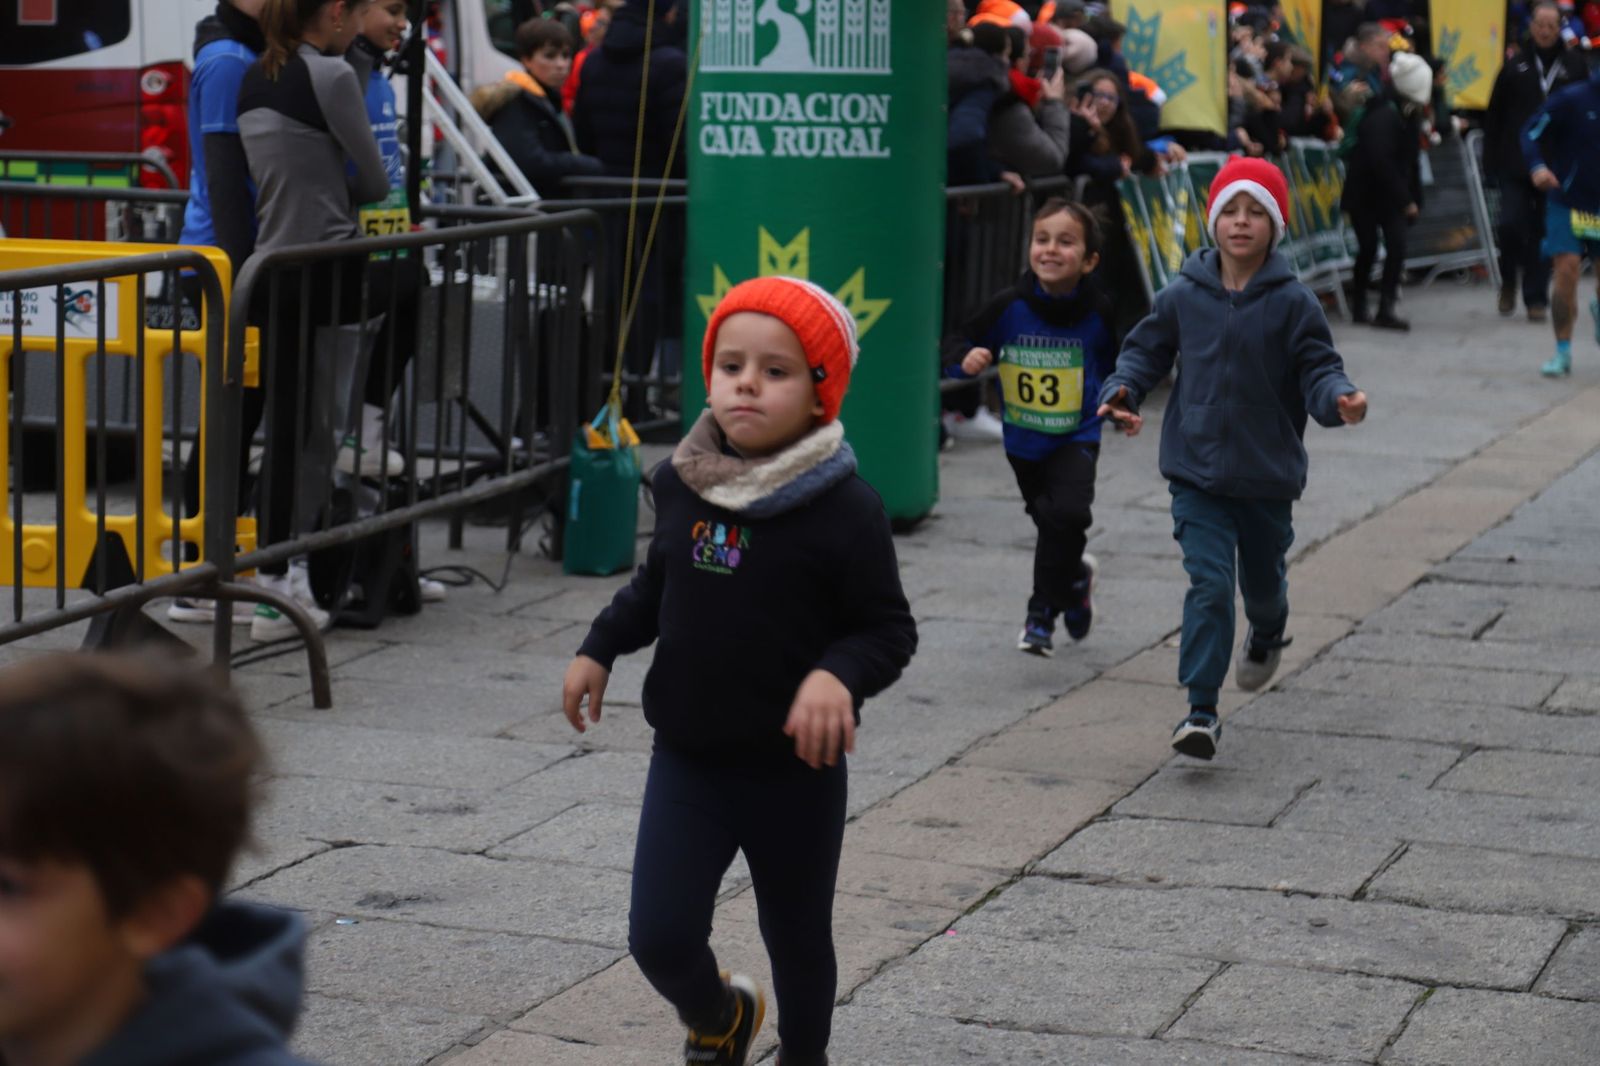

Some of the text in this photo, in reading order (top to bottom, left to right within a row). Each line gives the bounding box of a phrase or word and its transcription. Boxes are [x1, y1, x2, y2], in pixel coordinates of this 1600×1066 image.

[700, 92, 891, 123] FUNDACION
[700, 124, 890, 157] CAJA RURAL
[1017, 371, 1060, 407] 63
